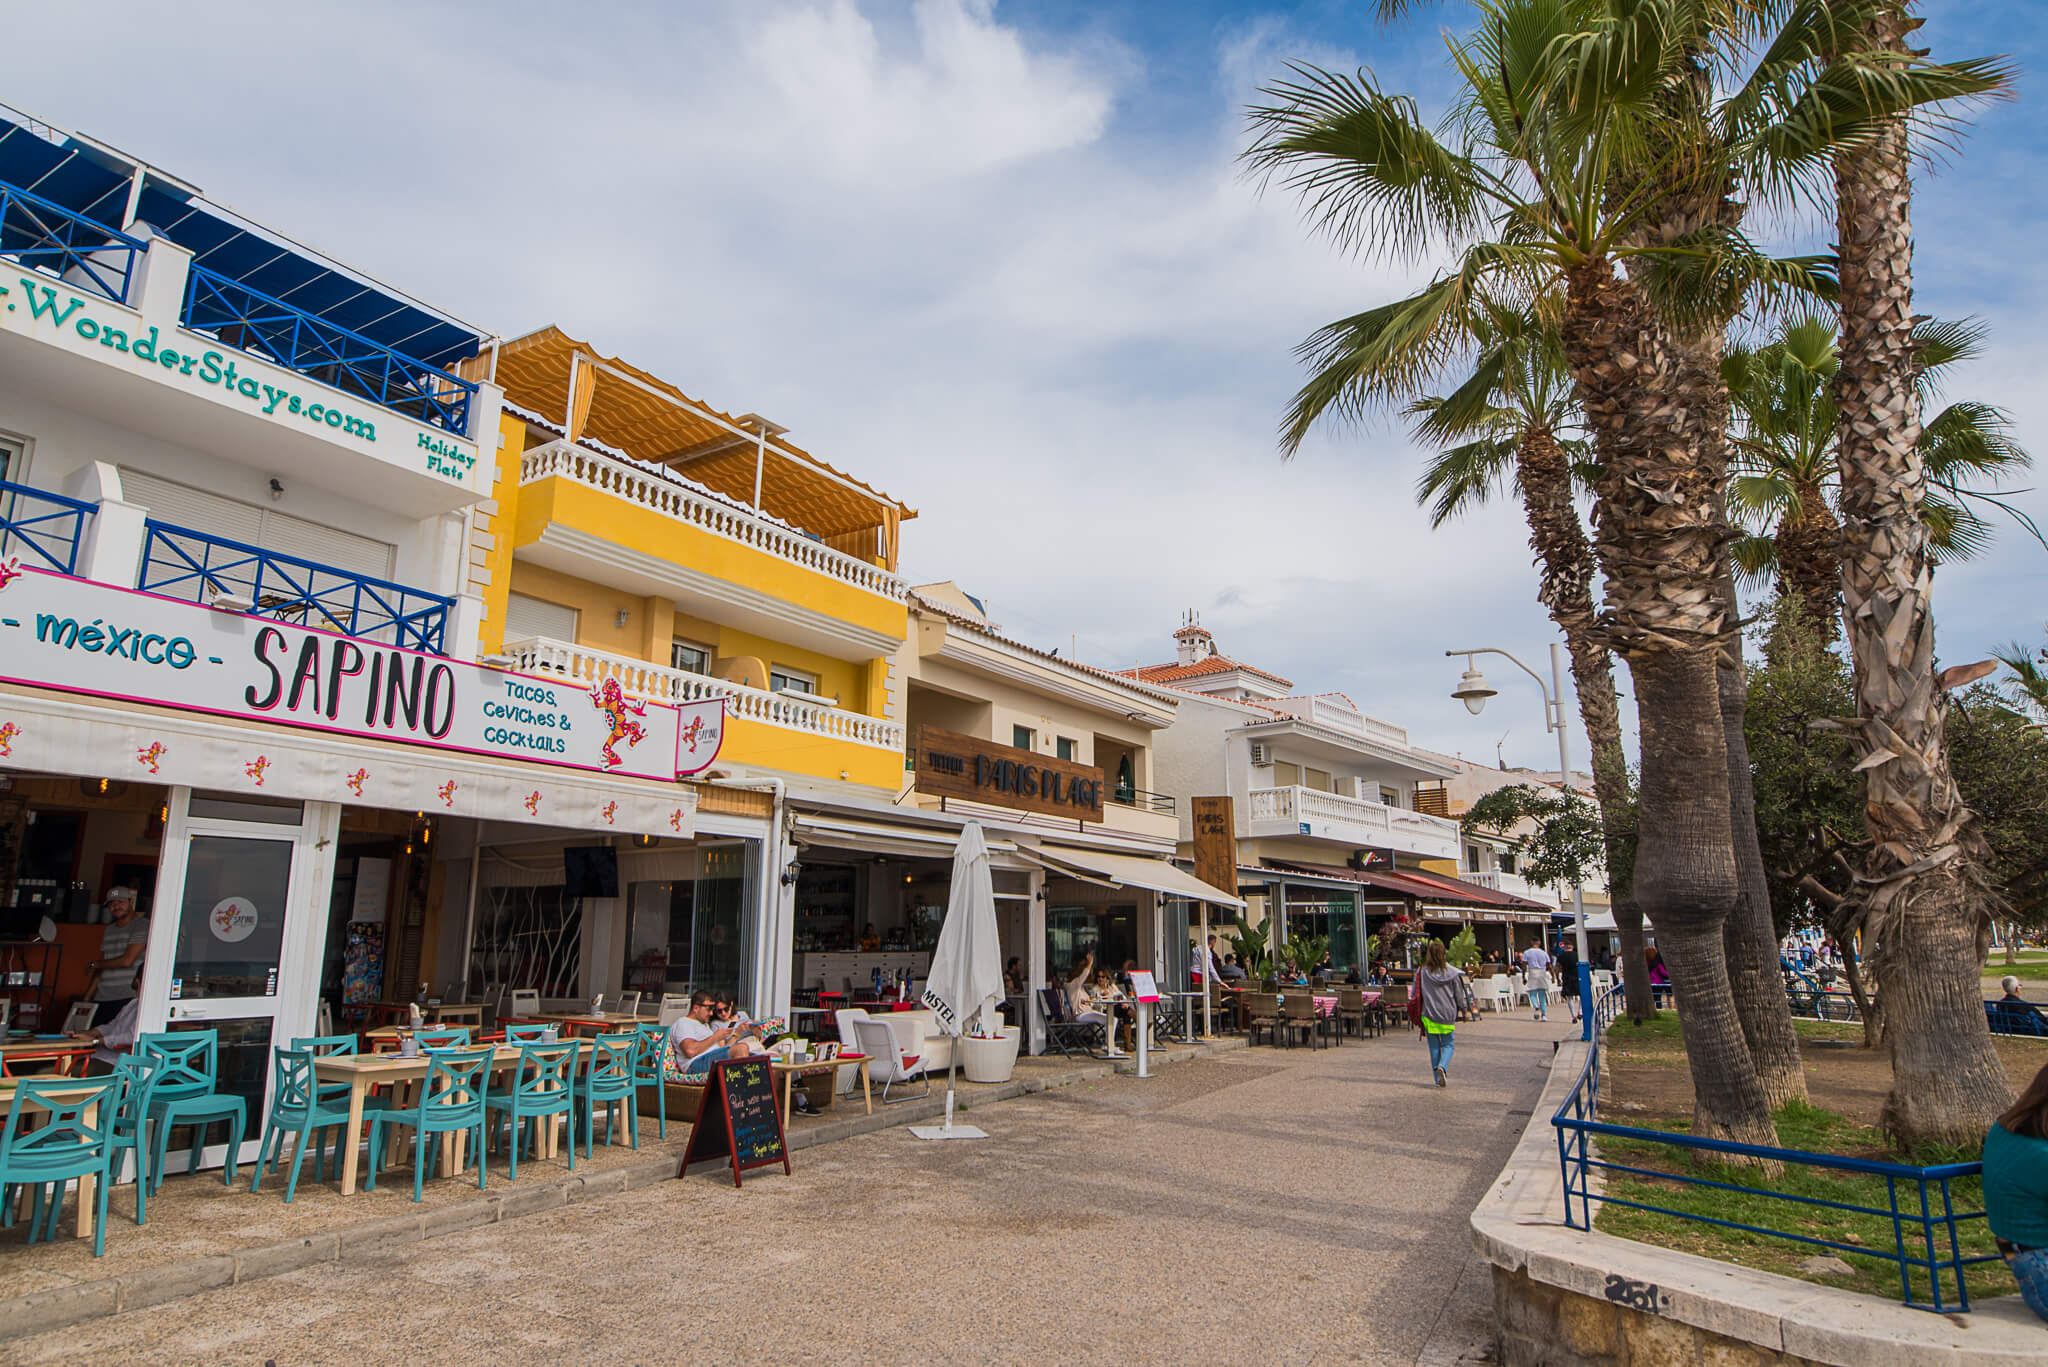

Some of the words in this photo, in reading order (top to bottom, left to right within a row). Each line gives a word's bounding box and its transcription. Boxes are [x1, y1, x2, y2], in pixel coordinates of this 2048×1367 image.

[0, 278, 377, 441] .WonderStays.com
[417, 432, 476, 469] Holiday
[427, 455, 463, 480] Flats
[244, 626, 456, 740] SAPINO
[504, 680, 557, 707] Tacos,
[483, 701, 556, 727] Ceviches
[559, 714, 571, 730] &
[484, 726, 565, 753] Cocktails
[975, 753, 1039, 797] PARIS
[1042, 769, 1104, 810] PLAGE
